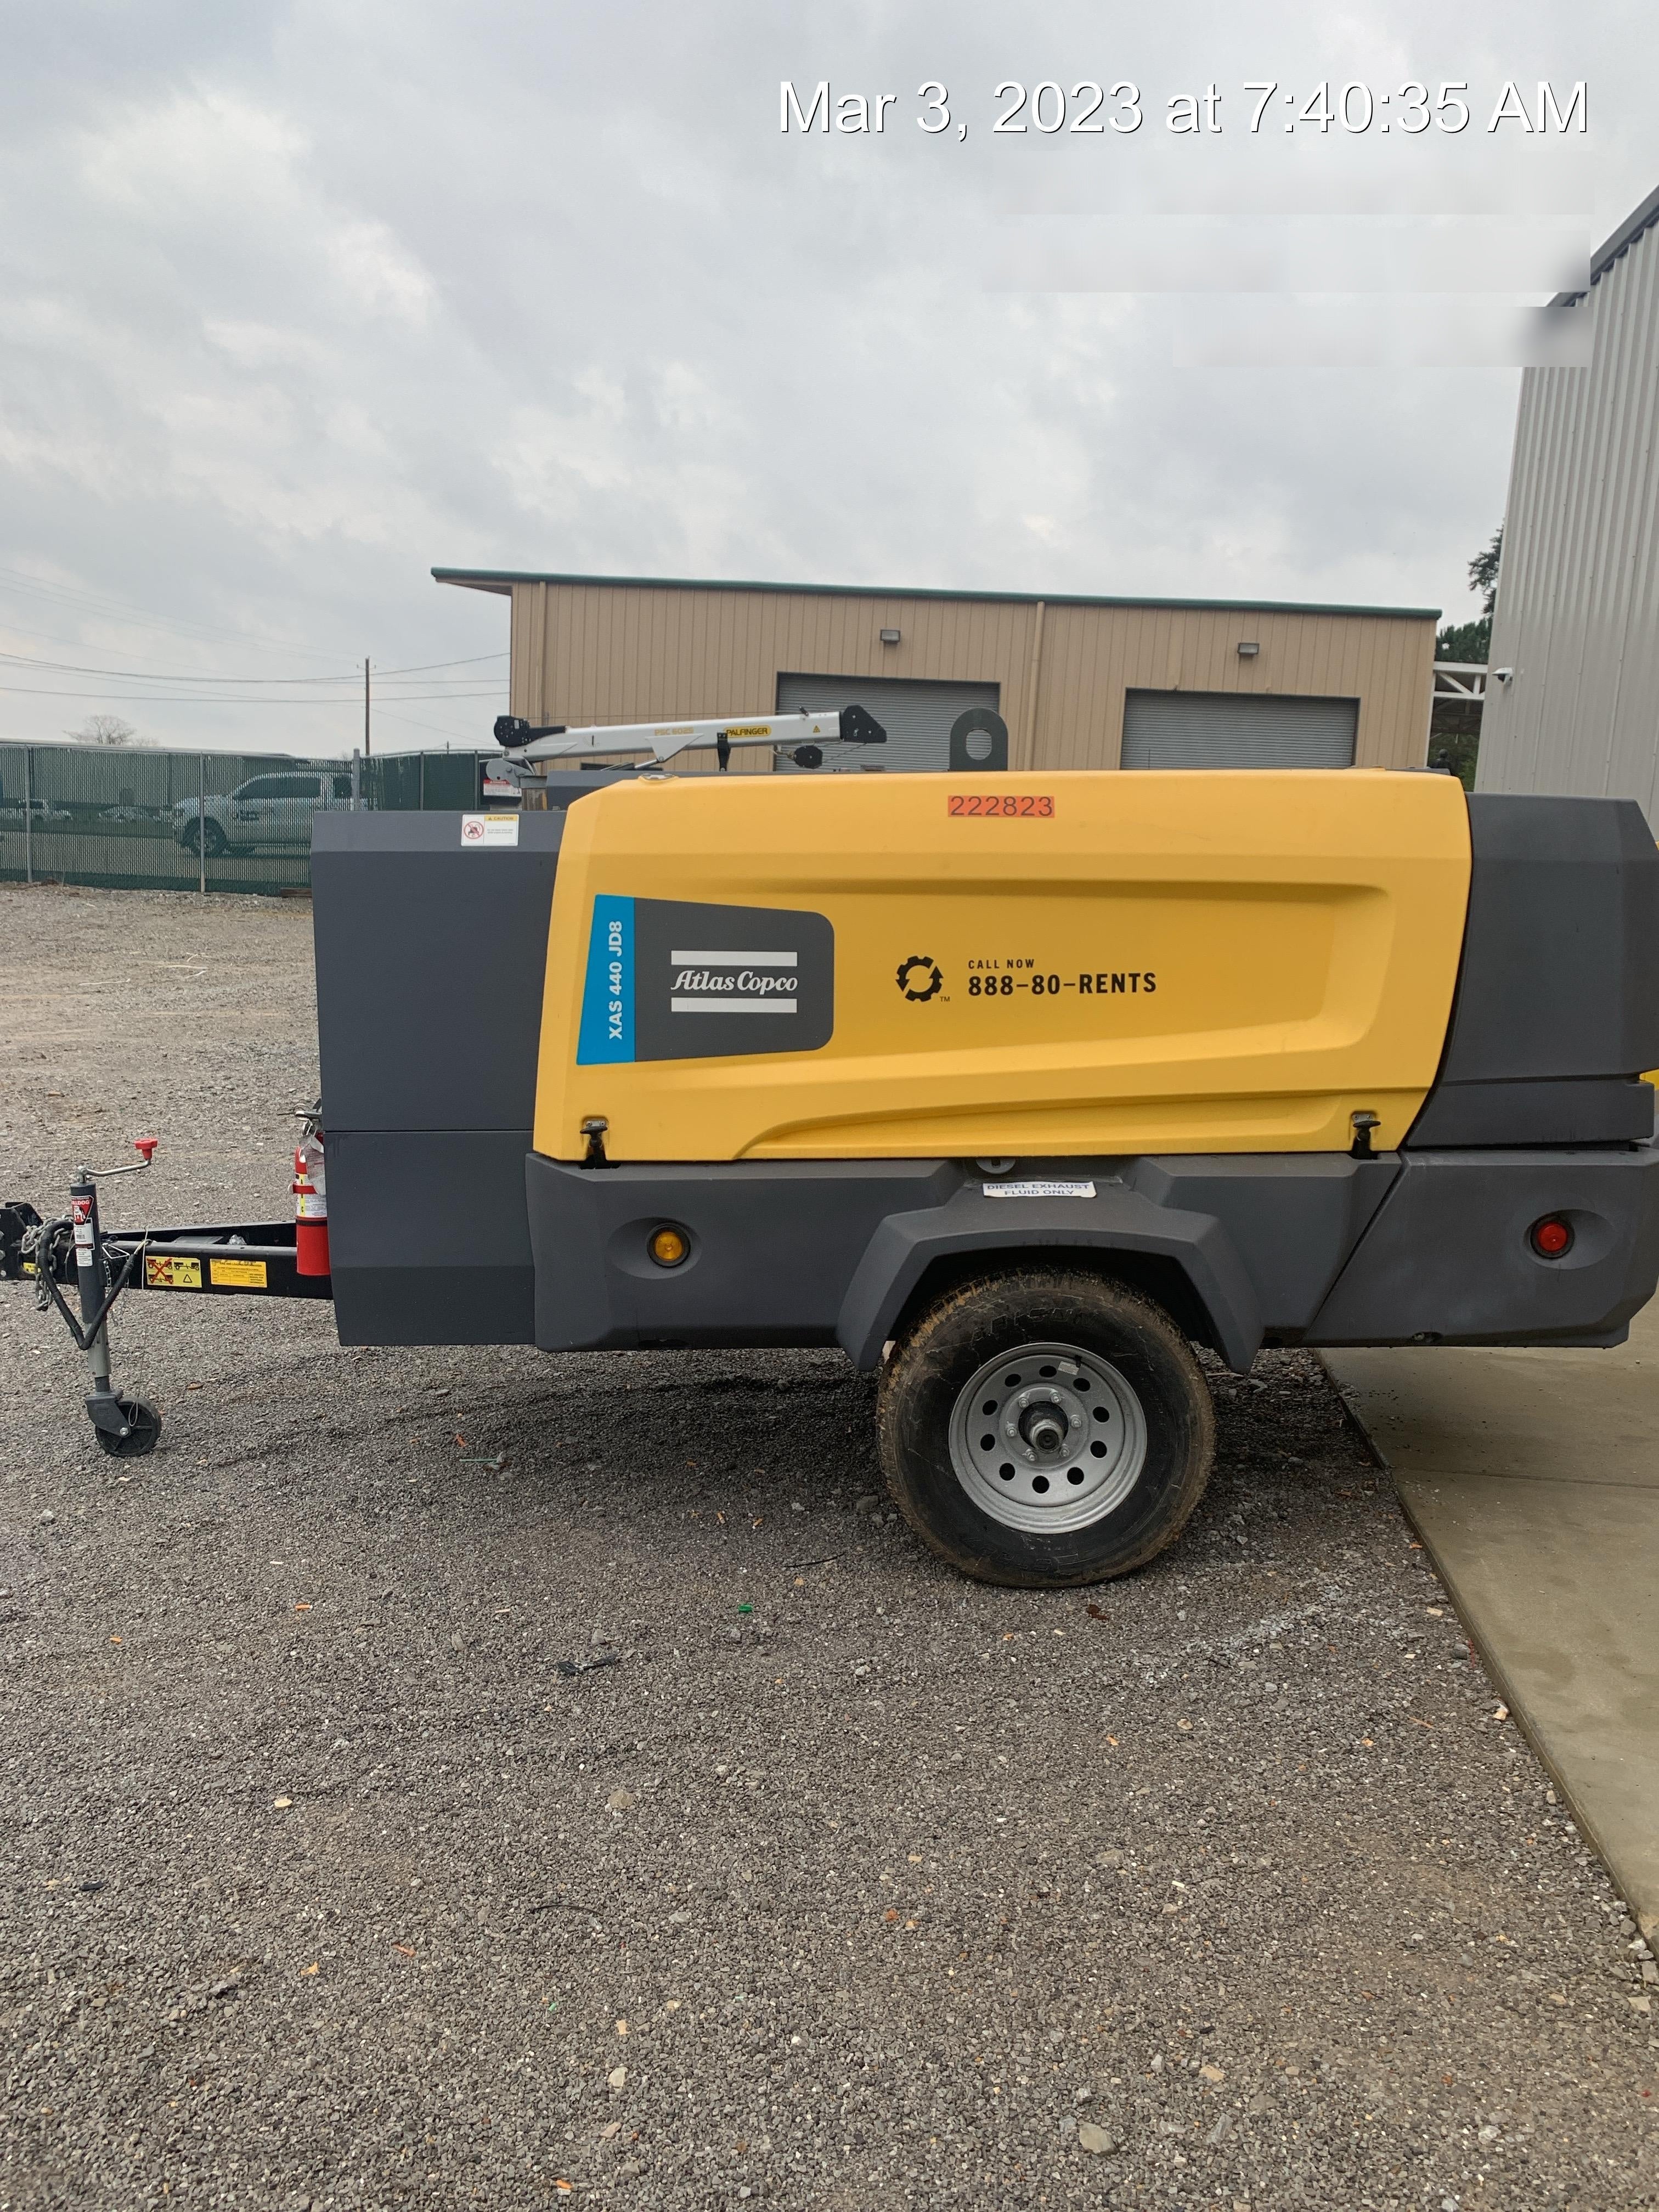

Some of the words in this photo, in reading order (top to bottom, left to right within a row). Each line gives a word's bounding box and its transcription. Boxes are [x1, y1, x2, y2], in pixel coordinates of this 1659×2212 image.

[726, 727, 768, 736] PALFINGER
[950, 796, 1053, 816] 222823
[608, 921, 623, 957] JD8
[968, 960, 1000, 969] CALL
[1006, 958, 1035, 969] NOW
[608, 961, 623, 996] 440
[670, 970, 735, 991] Atlas
[736, 970, 798, 995] Copco
[968, 972, 1157, 996] 888-80-RENTS
[608, 1000, 623, 1040] XAS
